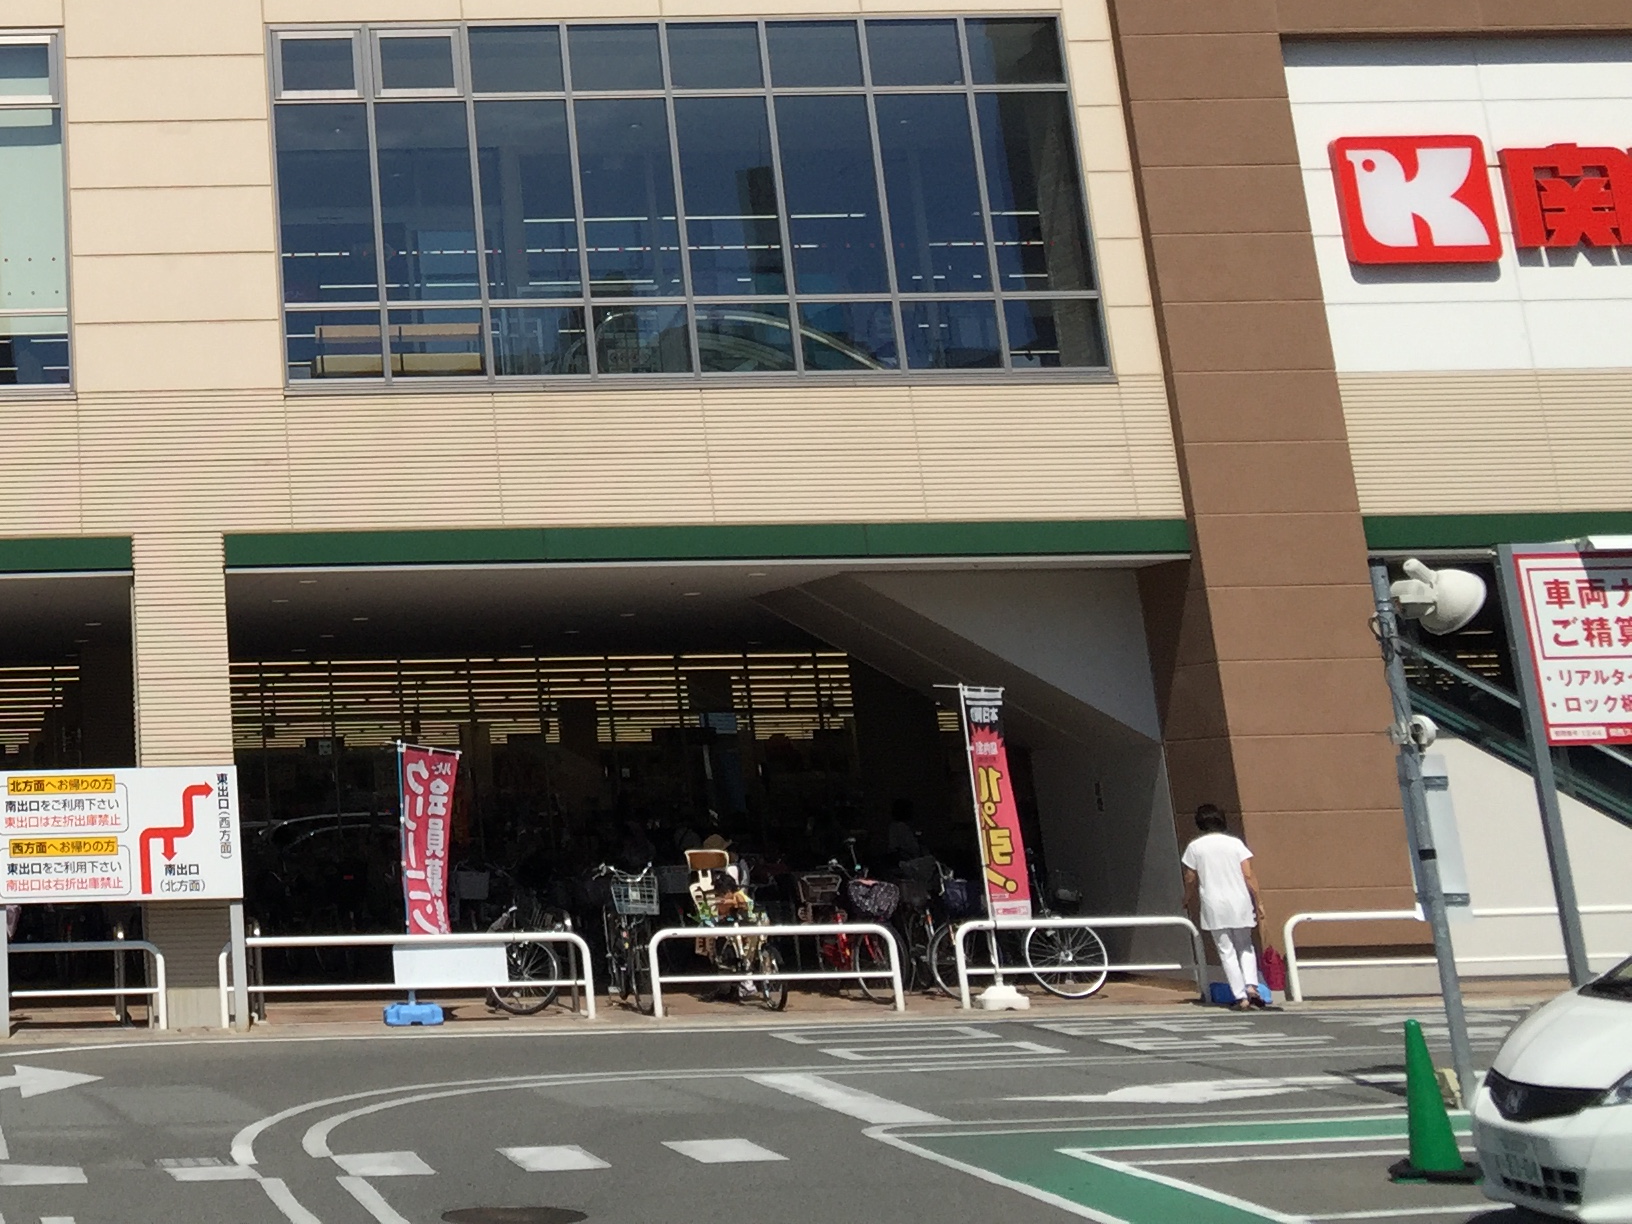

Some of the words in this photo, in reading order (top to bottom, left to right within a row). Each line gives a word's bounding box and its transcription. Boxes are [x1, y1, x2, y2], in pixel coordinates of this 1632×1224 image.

[1497, 142, 1632, 248] 関
[10, 777, 113, 793] 北方面へお帰りの方
[5, 798, 120, 813] 南出口をご利用下さい
[4, 814, 121, 829] 東出口は左折出庫禁止
[12, 840, 115, 855] 西方面へお帰りの方
[7, 860, 122, 876] 東出口をご利用下さい
[164, 864, 200, 877] 南出口
[6, 877, 124, 892] 南出口は右折出庫禁止
